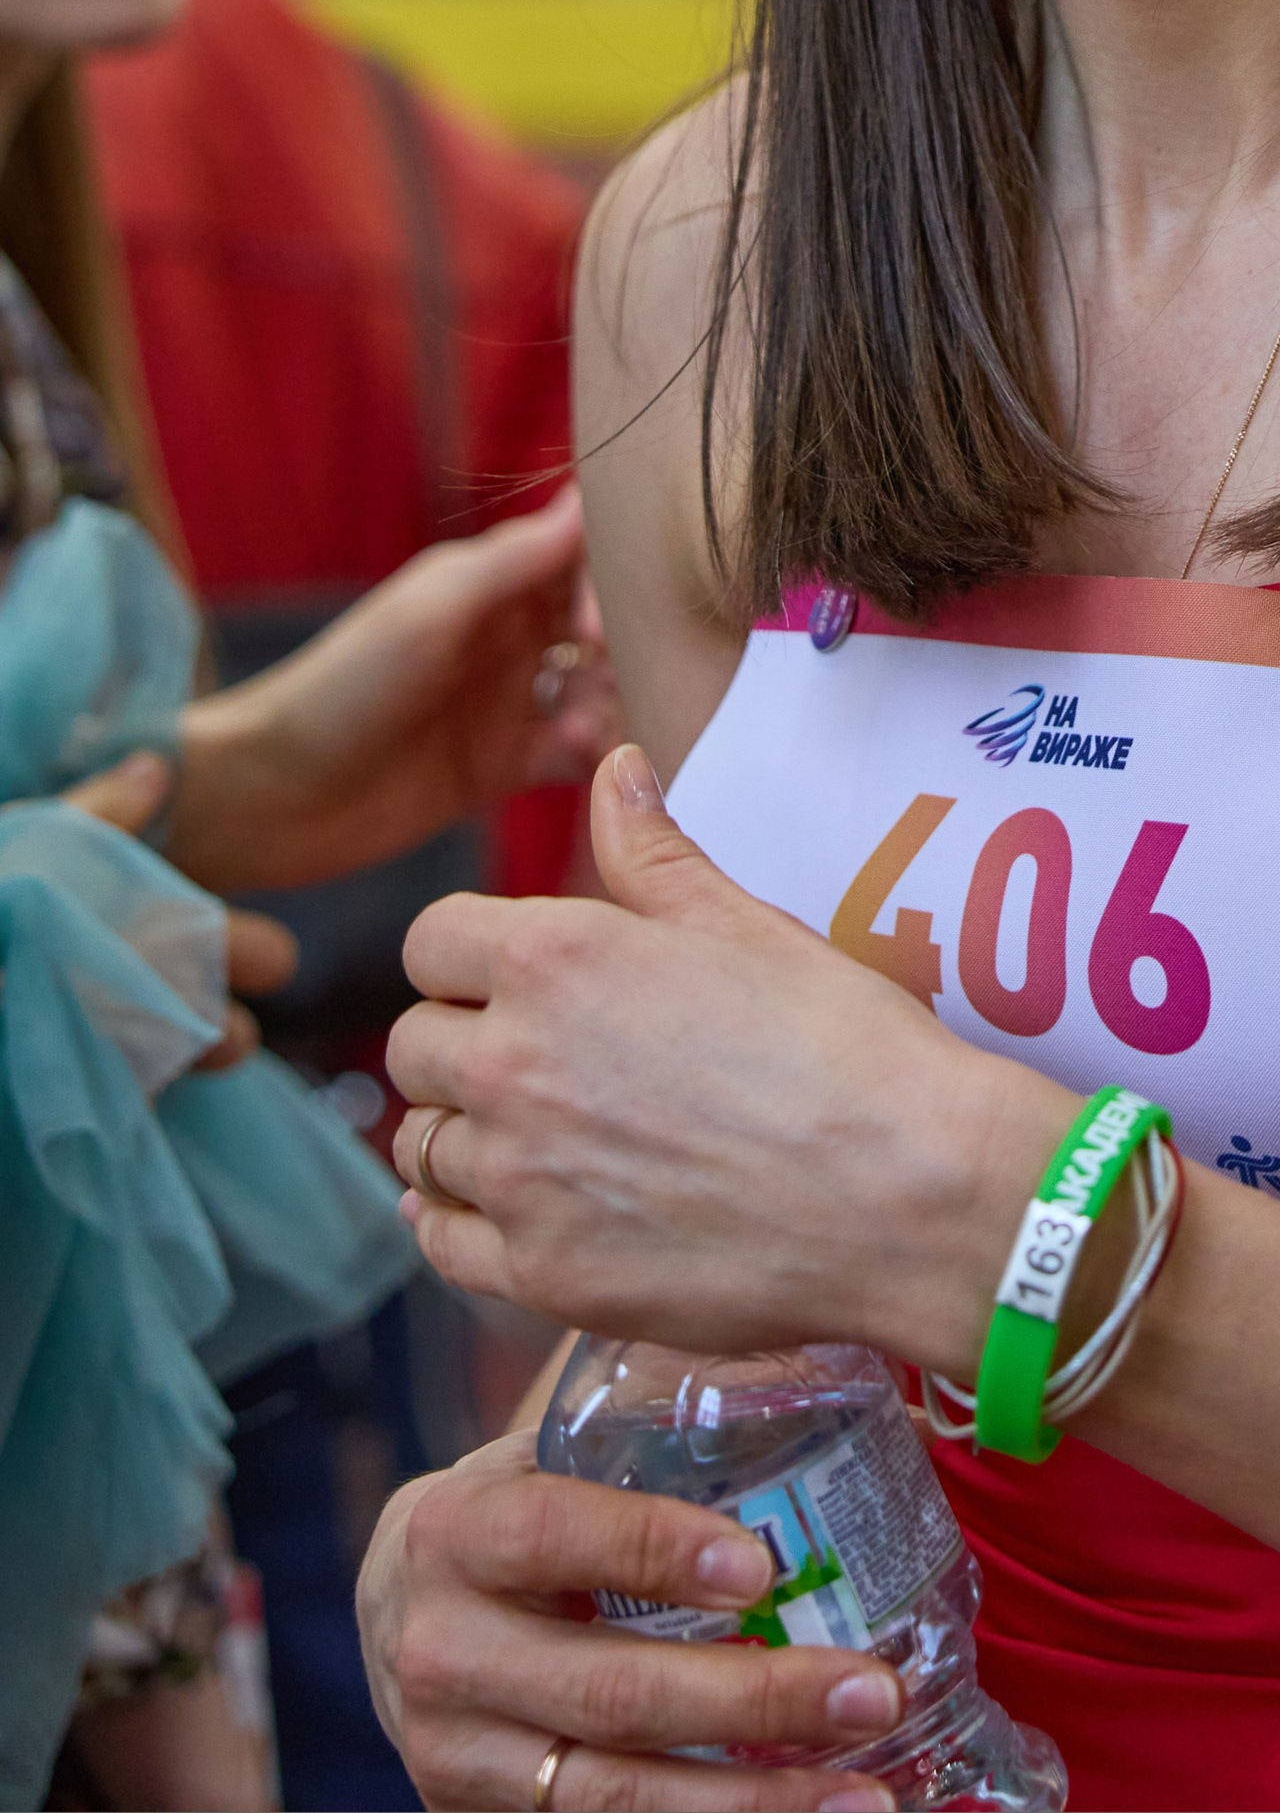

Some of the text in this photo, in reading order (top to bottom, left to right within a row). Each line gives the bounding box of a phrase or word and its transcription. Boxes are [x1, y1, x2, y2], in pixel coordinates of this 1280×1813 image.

[1043, 694, 1079, 729] НА
[1028, 730, 1134, 771] ВИРАЖЕ
[828, 792, 1212, 1056] 406
[1015, 1218, 1076, 1300] 163
